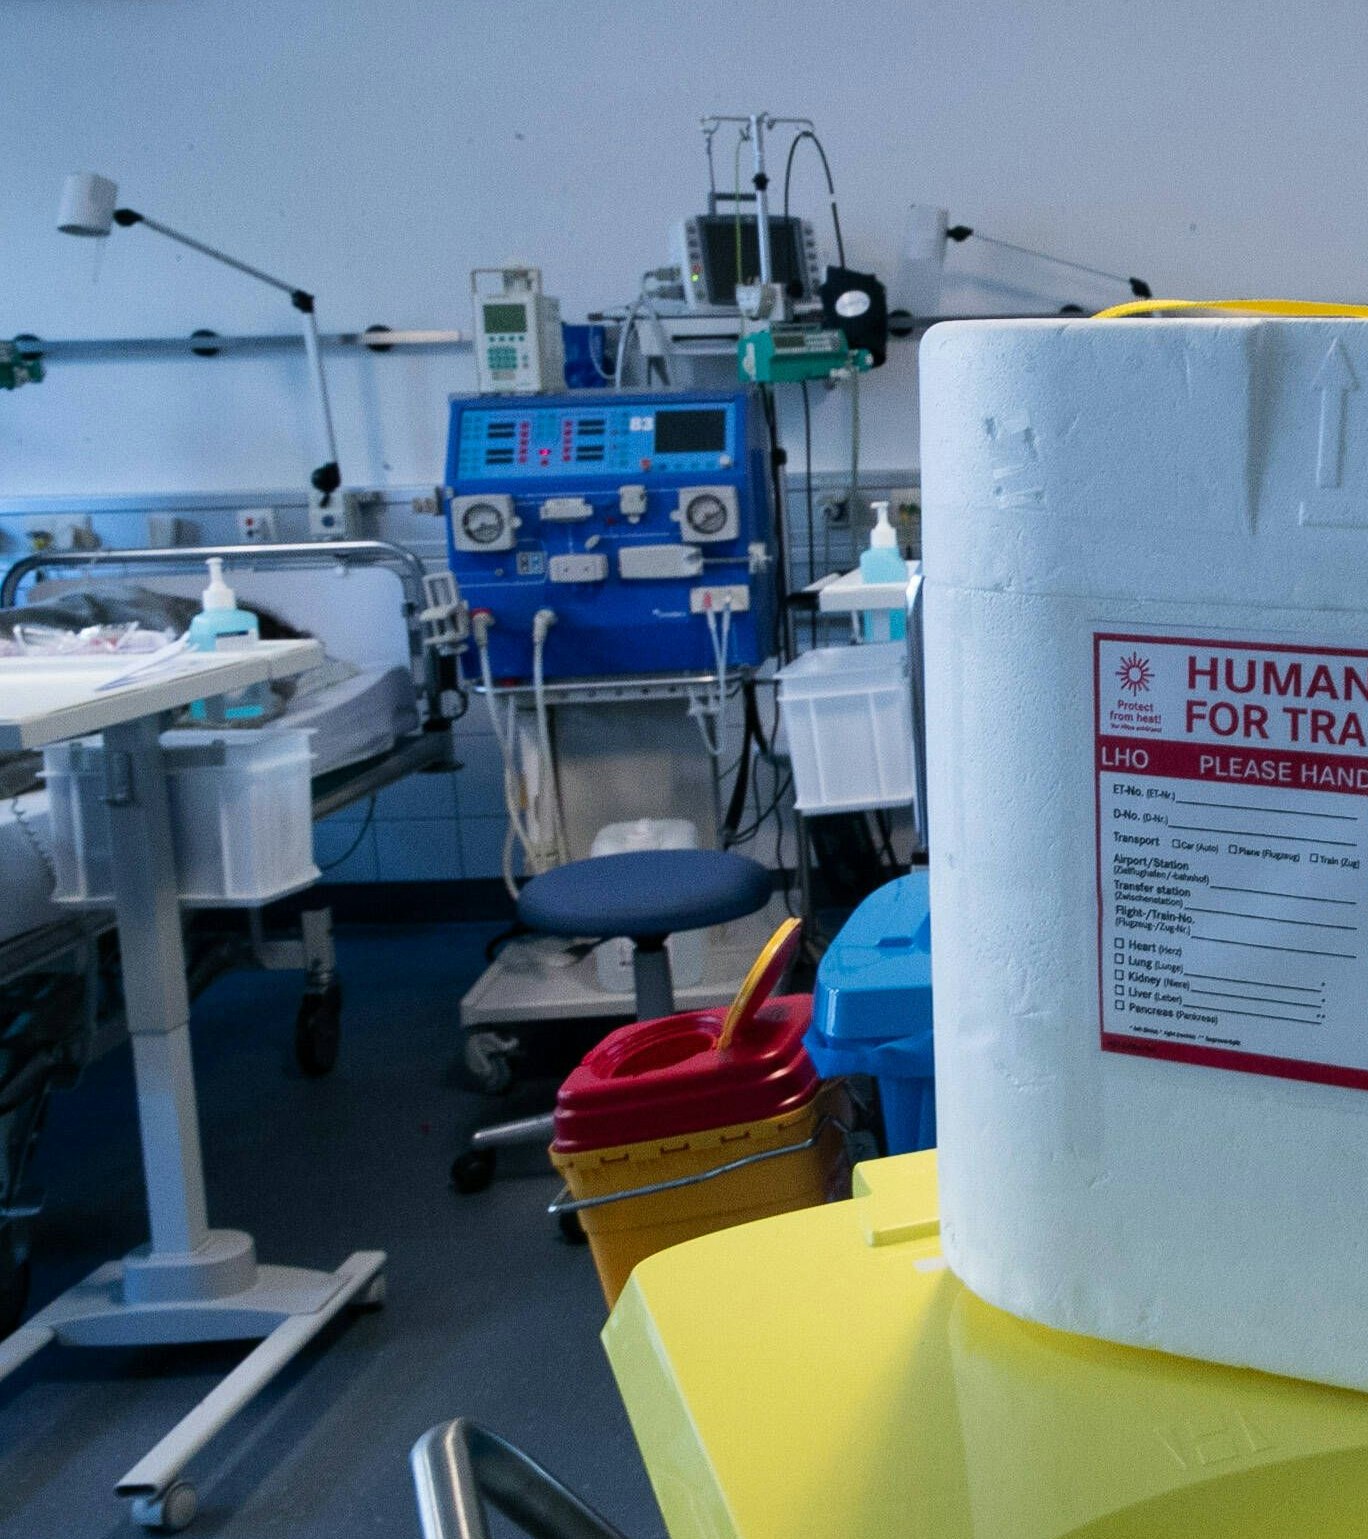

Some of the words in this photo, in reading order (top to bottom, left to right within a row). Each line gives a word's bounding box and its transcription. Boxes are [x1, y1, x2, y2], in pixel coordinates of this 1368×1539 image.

[1117, 699, 1153, 712] Protect
[1110, 710, 1134, 721] from
[1136, 713, 1162, 725] heat!
[1186, 699, 1268, 739] FOR
[1101, 746, 1149, 768] LHO
[1200, 755, 1292, 781] PLEASE
[1113, 784, 1144, 797] ET-No.
[1113, 808, 1141, 822] D-No.
[1113, 832, 1161, 847] Transport
[1181, 841, 1194, 851] Car
[1195, 842, 1219, 854] (Auto)
[1238, 847, 1260, 857] Plane
[1320, 855, 1339, 866] Train
[1341, 857, 1360, 869] (Zug)
[1114, 879, 1154, 893] Transfer
[1157, 885, 1191, 898] station
[1128, 939, 1157, 952] Heart
[1158, 943, 1182, 956] (Herz)
[1128, 955, 1153, 970] Lung
[1154, 960, 1184, 975] (Lunge)
[1128, 971, 1161, 987] Kidney
[1163, 978, 1191, 991] (Niere)
[1128, 986, 1152, 999] Liver
[1154, 991, 1182, 1005] (Leber)
[1128, 1002, 1173, 1018] Pancreas
